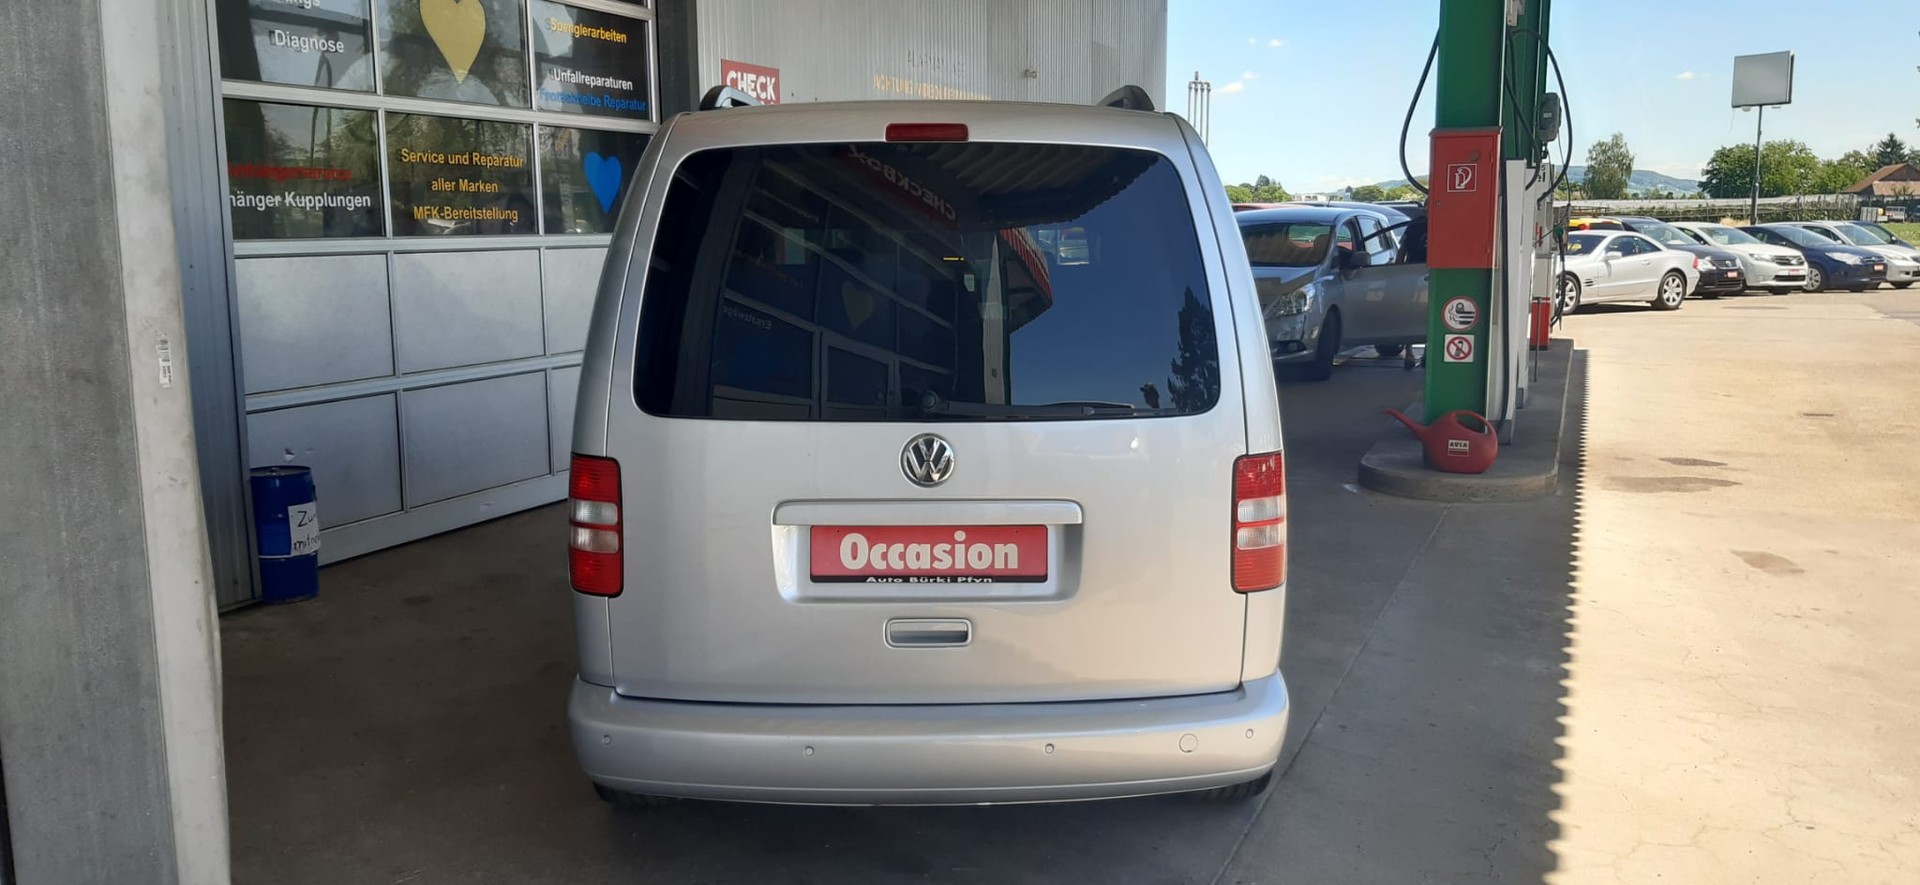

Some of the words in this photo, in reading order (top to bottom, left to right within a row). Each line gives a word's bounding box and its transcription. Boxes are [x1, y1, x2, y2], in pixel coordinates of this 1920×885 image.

[274, 29, 345, 53] Diagnose
[553, 68, 633, 90] Unfallreparaturen
[727, 70, 776, 101] CHECK
[604, 95, 646, 111] Reparatur
[401, 148, 445, 164] Service
[448, 152, 469, 165] und
[472, 152, 523, 168] Reparatur
[431, 178, 455, 191] aller
[459, 179, 498, 192] Marken
[285, 191, 371, 211] Kupplungen
[413, 206, 518, 222] MFK-Bereitstellung
[899, 432, 954, 488] VW
[840, 531, 1019, 570] Occasion
